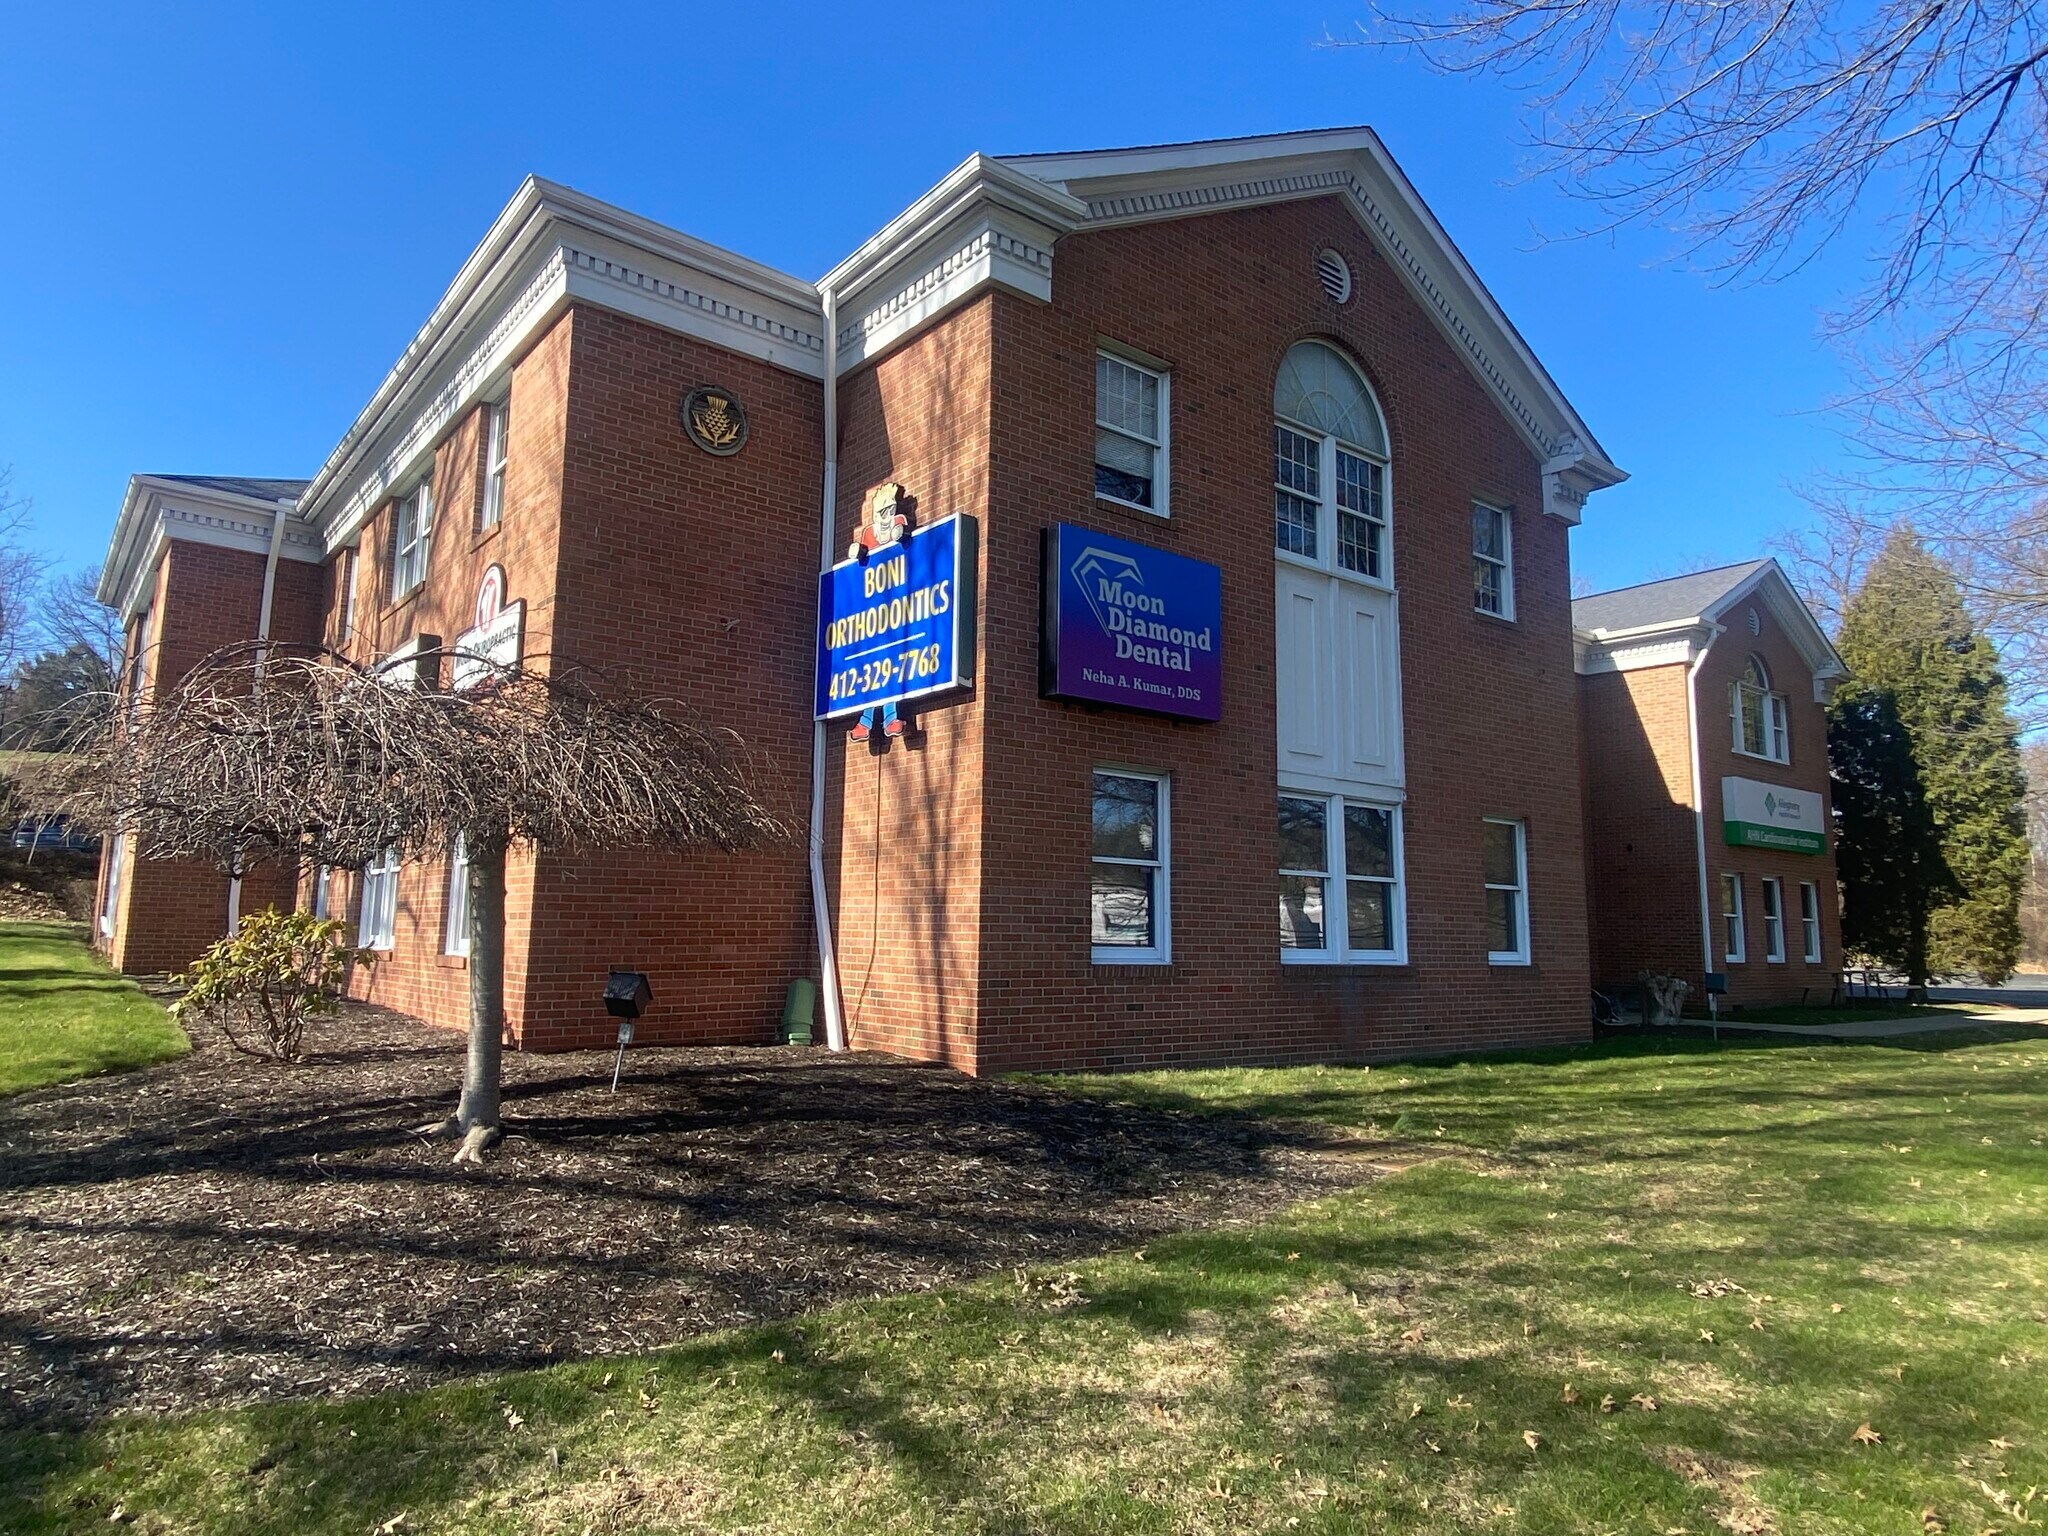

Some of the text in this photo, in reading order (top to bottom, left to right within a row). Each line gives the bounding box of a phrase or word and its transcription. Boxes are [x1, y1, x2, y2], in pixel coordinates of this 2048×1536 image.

[864, 554, 906, 599] BONI
[1098, 577, 1165, 616] Moon
[825, 579, 949, 650] ORTHODONTICS
[1108, 606, 1211, 651] Diamond
[829, 643, 940, 701] 412-329-7768
[1115, 634, 1191, 672] Dental
[1082, 668, 1201, 701] Neha A. Kumar, DDS
